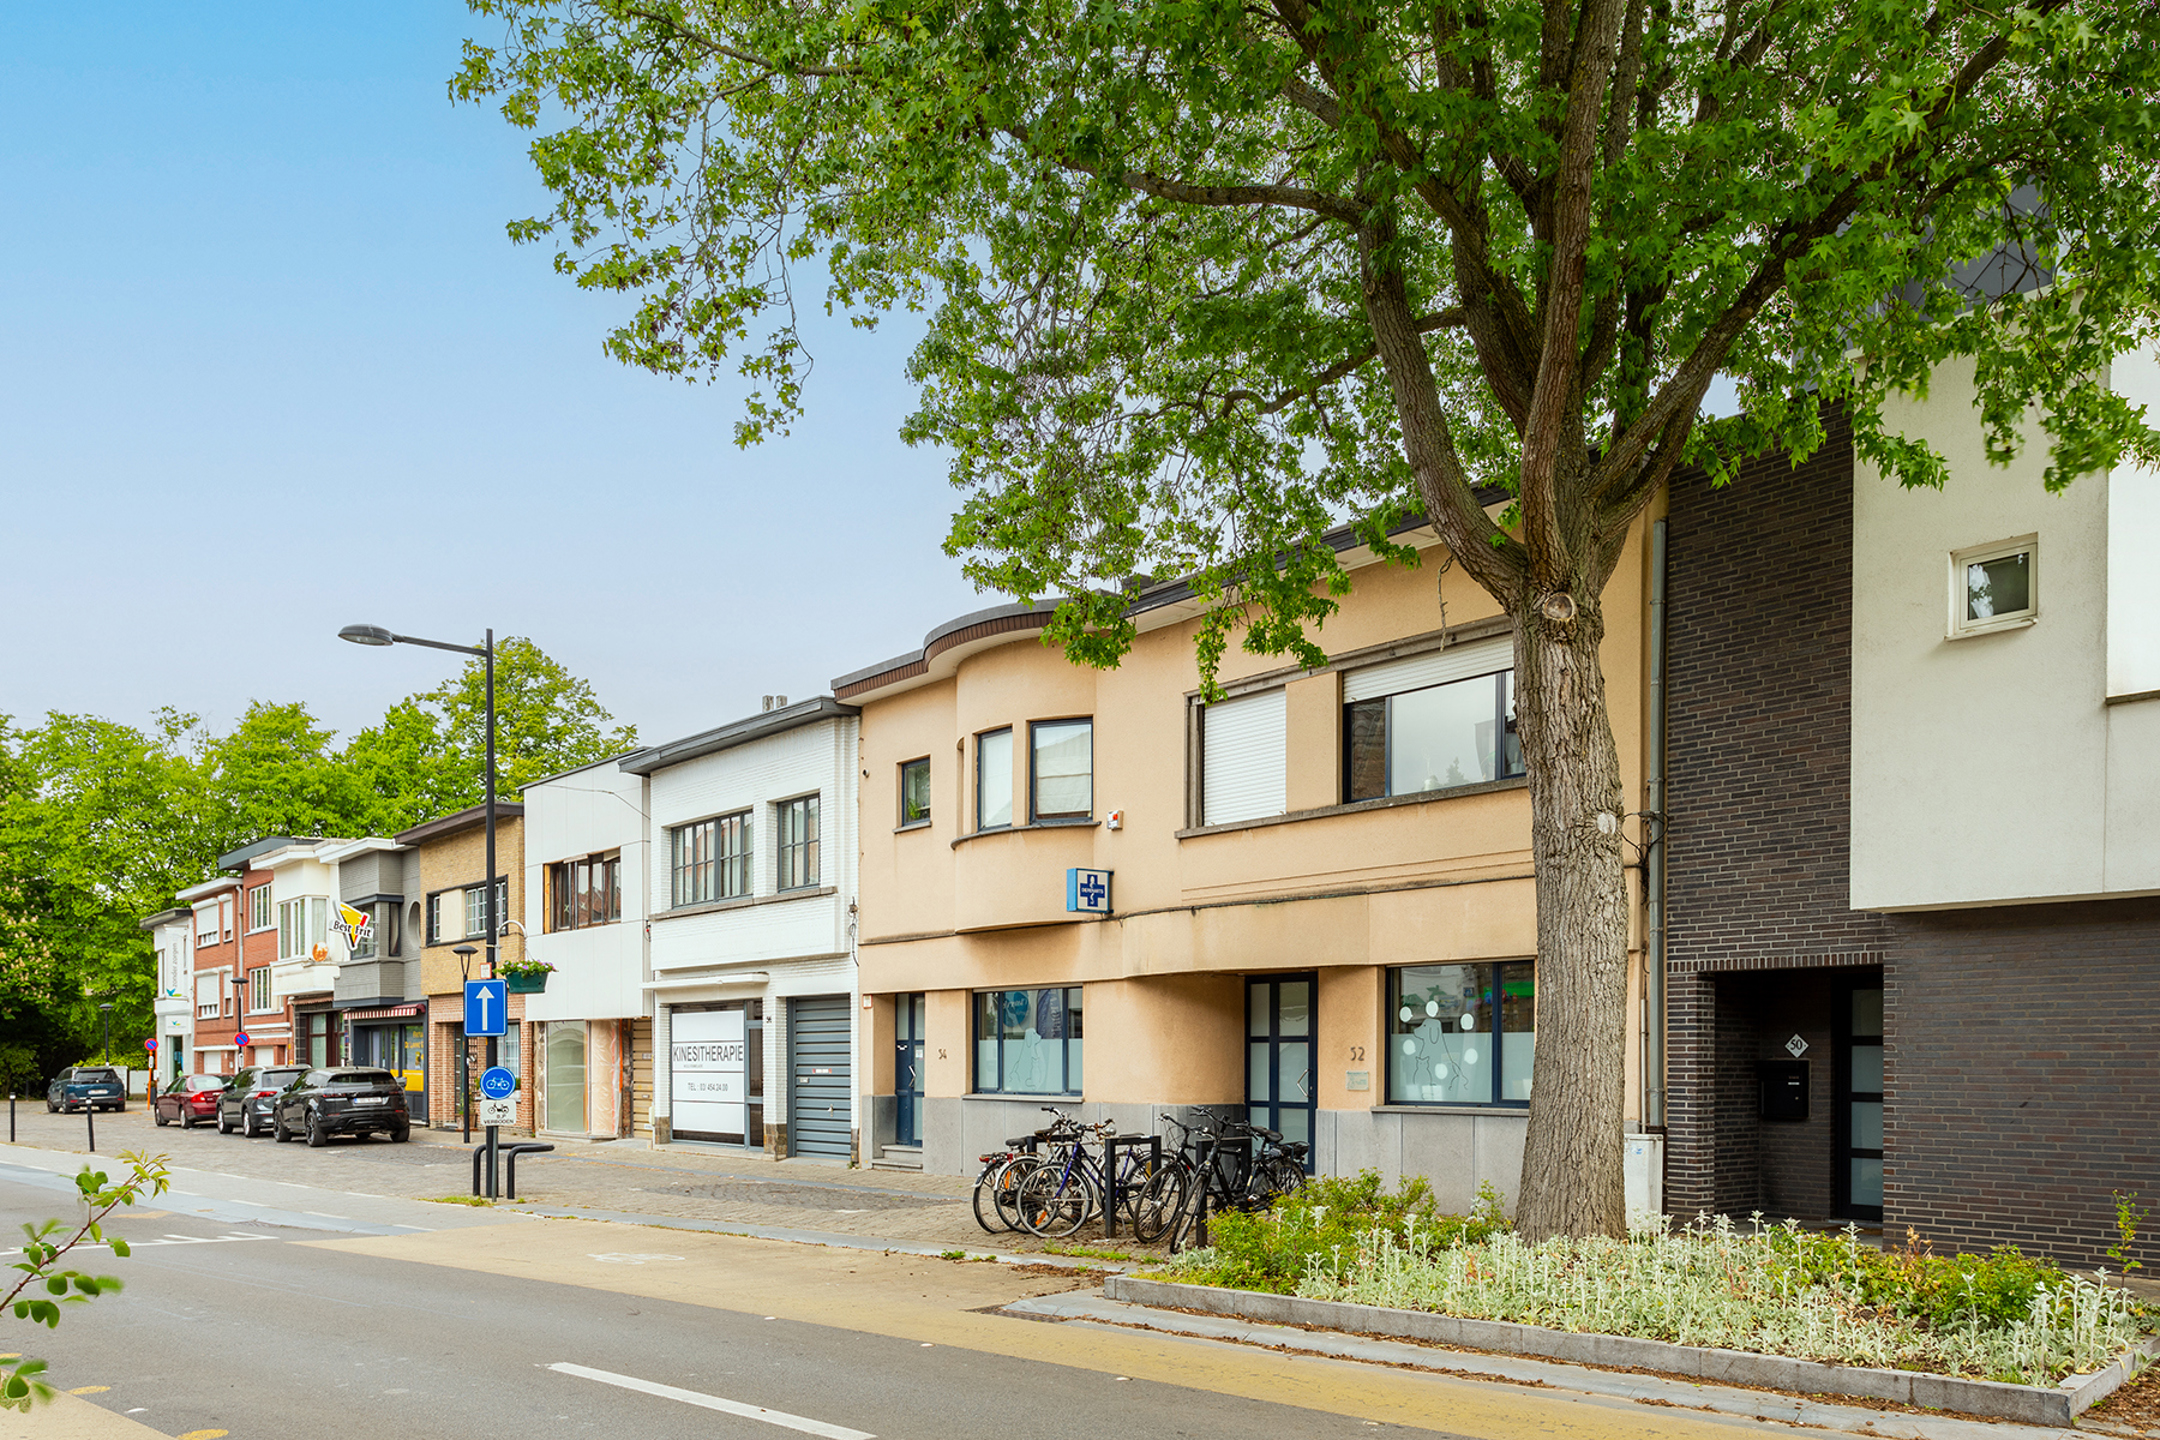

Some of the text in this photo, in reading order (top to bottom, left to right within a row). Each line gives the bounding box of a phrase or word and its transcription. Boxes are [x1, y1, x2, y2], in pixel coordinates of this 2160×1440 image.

[333, 920, 371, 937] Best Frit
[1790, 1039, 1803, 1051] 50
[672, 1045, 744, 1062] KINESITHERAPIE
[1350, 1046, 1365, 1061] 52
[687, 1082, 697, 1091] TEL
